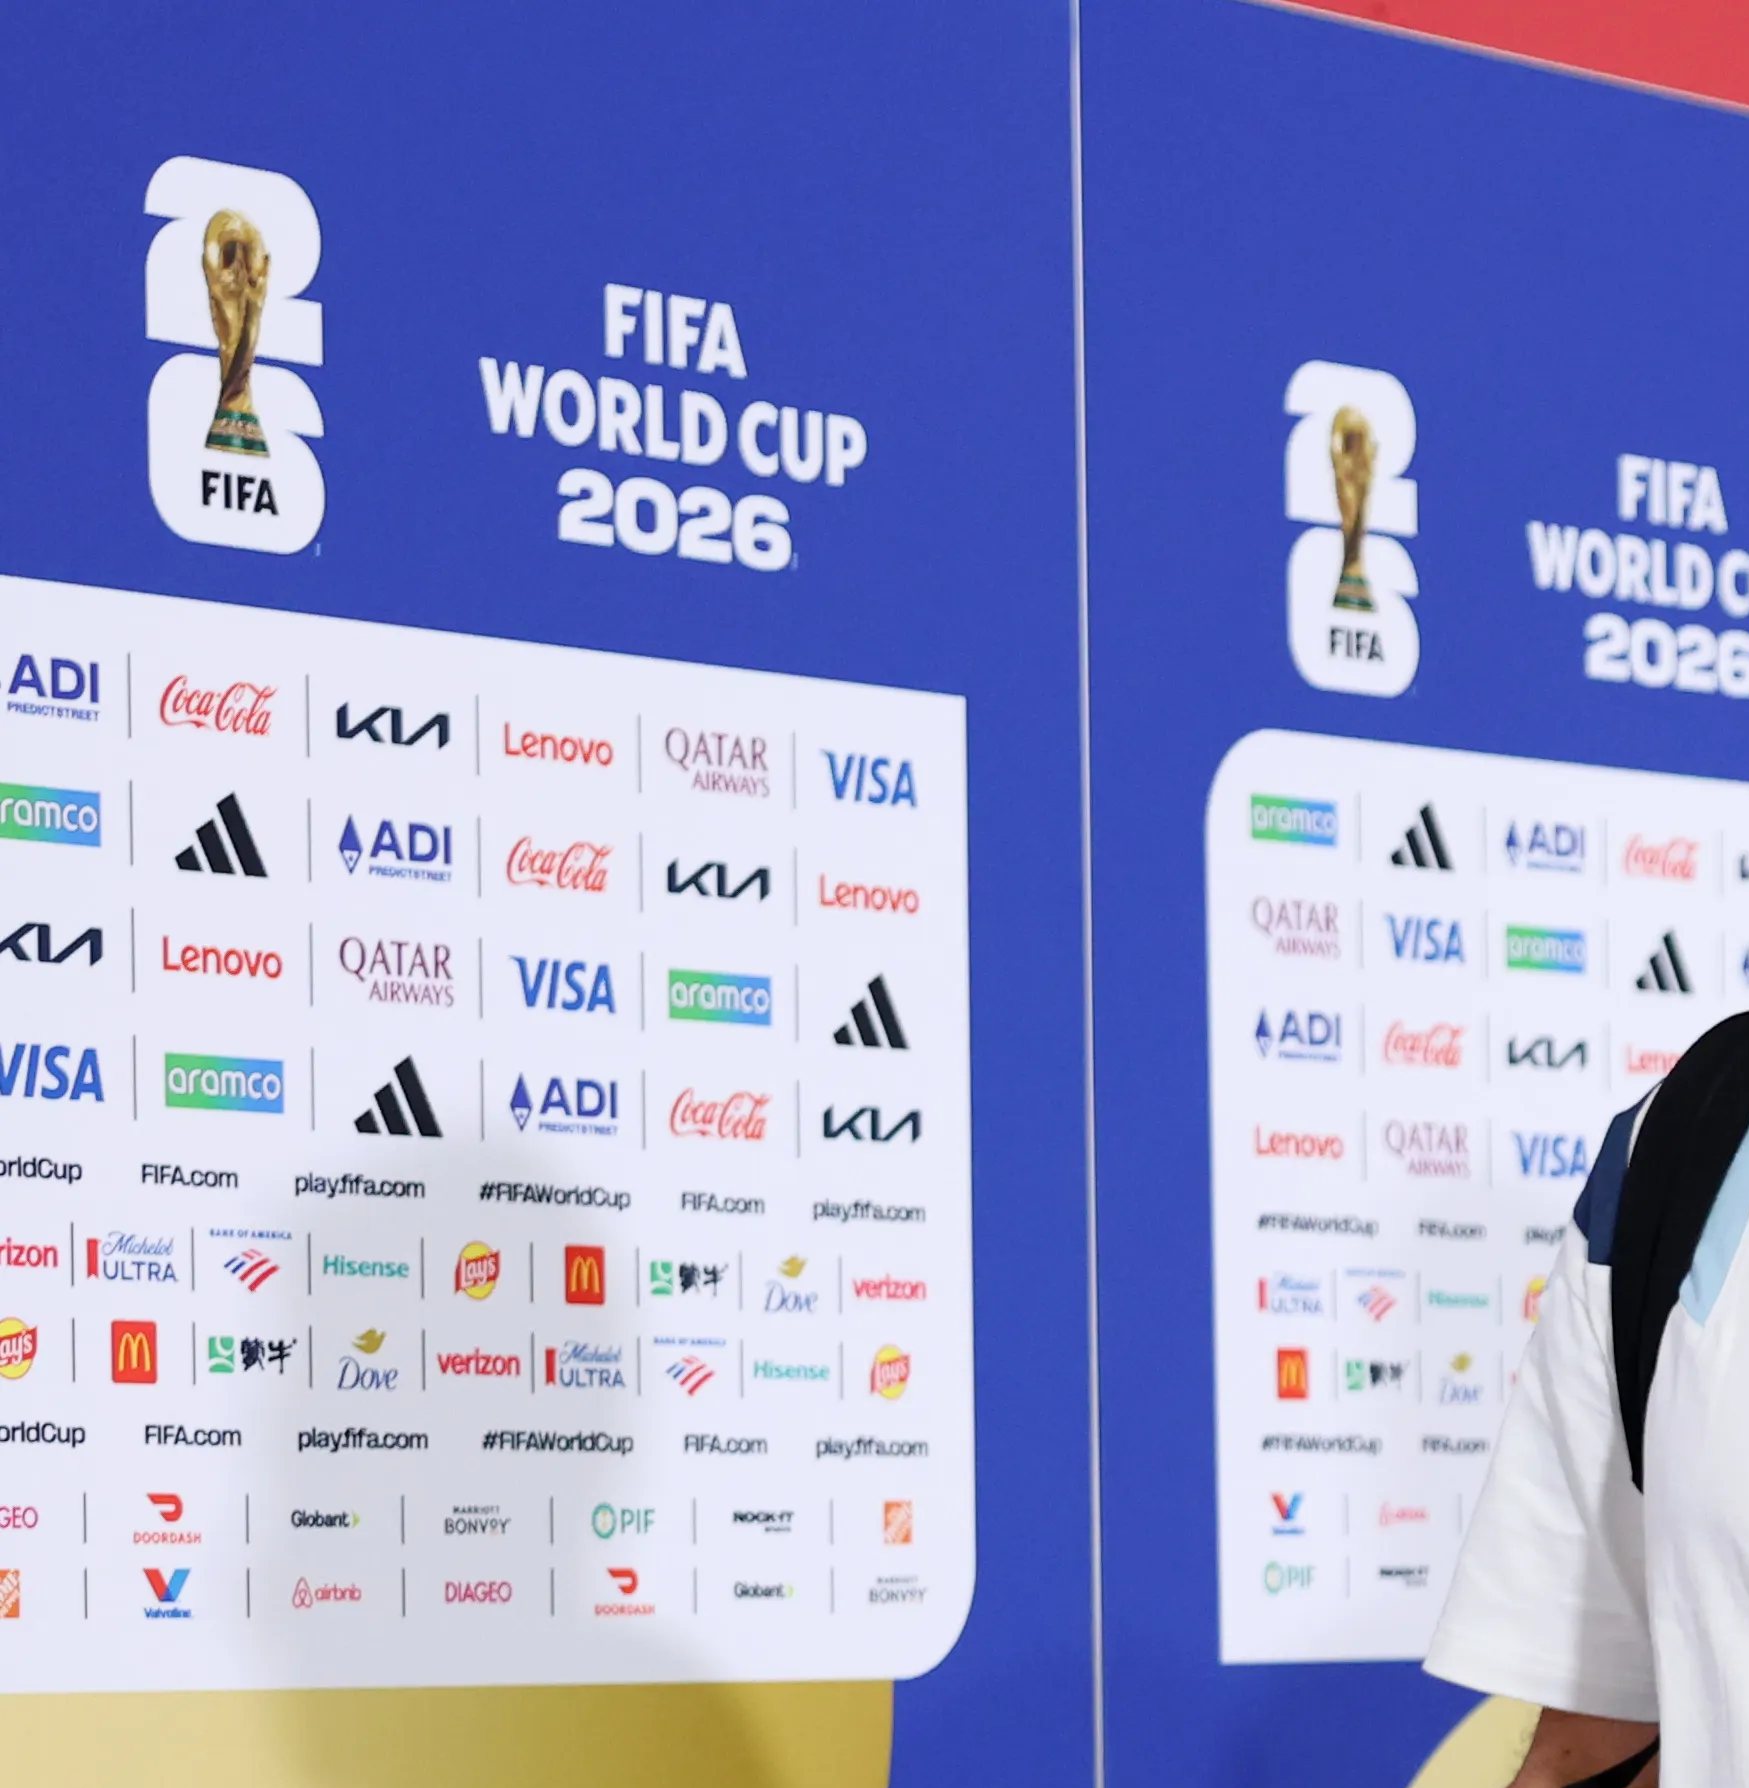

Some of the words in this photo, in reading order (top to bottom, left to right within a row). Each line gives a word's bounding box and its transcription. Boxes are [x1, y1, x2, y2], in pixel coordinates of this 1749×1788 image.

[605, 284, 747, 378] FIFA
[479, 357, 727, 465] WORLD
[738, 401, 866, 486] CUP
[202, 470, 278, 515] FIFA
[1618, 454, 1728, 534] FIFA
[557, 468, 793, 571] 2026
[1527, 521, 1713, 609] WORLD
[1329, 626, 1383, 661] FIFA
[8, 654, 99, 703] ADI
[8, 700, 99, 722] PREDICTSTREET
[504, 723, 613, 766] Lenovo
[665, 727, 769, 772] QATAR
[692, 770, 770, 798] AIRWAYS
[825, 752, 916, 807] VISA
[370, 820, 451, 865] ADI
[1529, 823, 1585, 858] ADI
[819, 874, 919, 914] Lenovo
[1252, 897, 1339, 934] QATAR
[1387, 915, 1464, 962] VISA
[163, 936, 282, 979] Lenovo
[339, 936, 454, 982] QATAR
[370, 981, 454, 1008] AIRWAYS
[512, 956, 615, 1013] VISA
[670, 983, 770, 1014] aramco
[1279, 1010, 1341, 1047] ADI
[0, 1042, 104, 1102] VISA
[168, 1066, 282, 1100] aramco
[540, 1077, 617, 1119] ADI
[1255, 1126, 1343, 1160] Lenovo
[1385, 1119, 1469, 1158] QATAR
[1512, 1131, 1589, 1178] VISA
[142, 1164, 238, 1188] FIFA.com
[296, 1173, 425, 1199] play.fifa.com
[479, 1182, 630, 1210] #FIFAWorldCup
[681, 1192, 765, 1214] FIFA.com
[103, 1258, 177, 1282] ULTRA
[323, 1255, 409, 1278] Hisense
[764, 1285, 817, 1312] Dove
[853, 1275, 926, 1300] verizon
[338, 1357, 398, 1390] Dove
[437, 1348, 520, 1376] verizon
[559, 1366, 626, 1388] ULTRA
[753, 1361, 830, 1380] Hisense
[145, 1425, 241, 1446] FIFA.com
[298, 1427, 428, 1453] play.fifa.com
[482, 1431, 633, 1455] #FIFAWorldCup
[684, 1434, 767, 1454] FIFA.com
[291, 1511, 349, 1528] Globant
[445, 1518, 511, 1535] BONVOY
[621, 1509, 655, 1533] PIF
[133, 1531, 201, 1544] DOORDASH
[315, 1587, 361, 1602] airbnb
[445, 1581, 512, 1604] DIAGEO
[595, 1603, 655, 1615] DOORDASH
